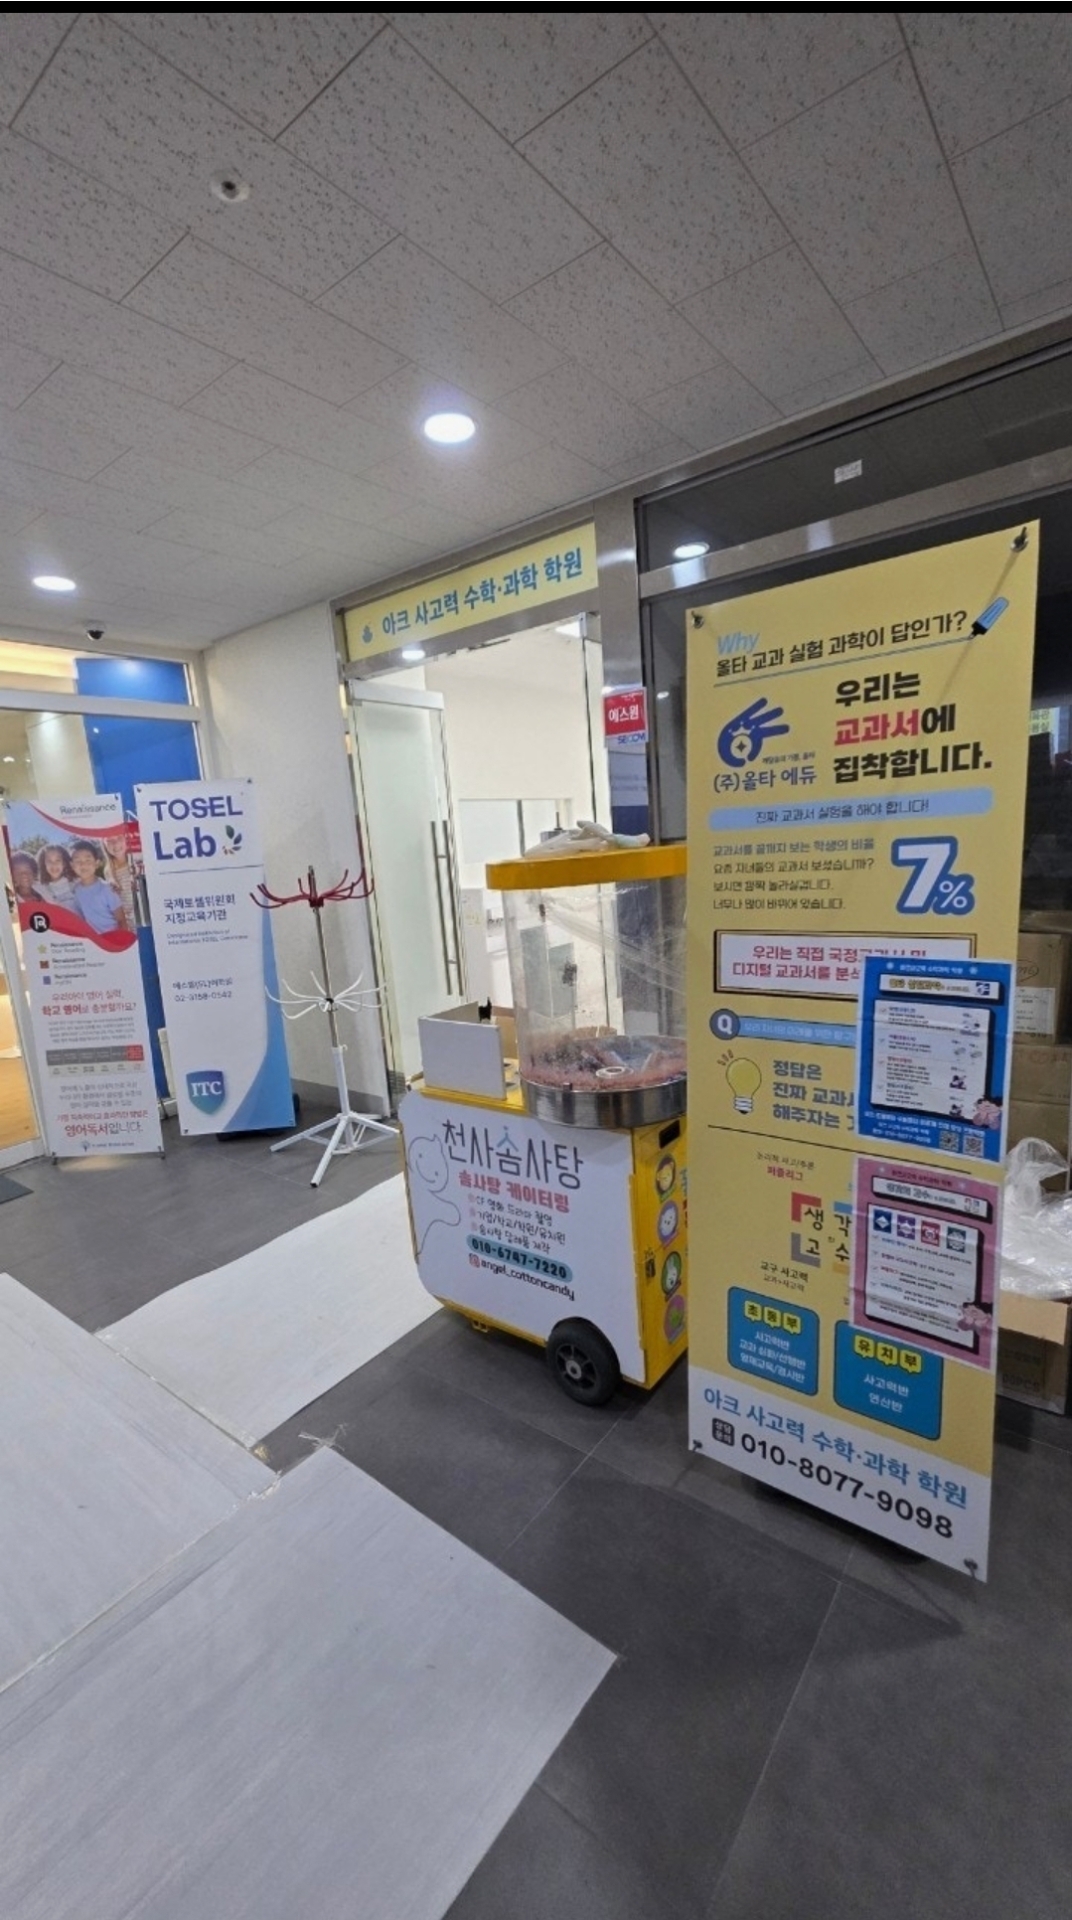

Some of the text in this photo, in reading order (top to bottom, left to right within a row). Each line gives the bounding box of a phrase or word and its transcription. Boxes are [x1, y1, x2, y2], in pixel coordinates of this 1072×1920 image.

[382, 612, 410, 636] 아크
[414, 591, 458, 626] 사고력
[543, 548, 583, 584] 학원
[716, 610, 967, 678] 올타 교과 실험 과학이 답인가?
[717, 631, 759, 654] Why
[835, 672, 921, 707] 우리는
[608, 703, 639, 723] 에스원
[834, 703, 957, 746] 교과서에
[833, 742, 992, 785] 집착합니다.
[713, 766, 817, 793] (주)올타 에듀
[59, 802, 117, 815] Renaissance
[149, 795, 243, 822] TOSEL
[755, 799, 930, 824] 진짜 교과서 실험을 해야 합니다!
[153, 826, 217, 861] Lab
[713, 844, 753, 857] 교과서를
[789, 841, 811, 853] 보는
[813, 839, 848, 852] 학생의
[851, 838, 874, 850] 비율
[713, 863, 732, 874] 요즘
[735, 861, 775, 874] 자녀들의
[777, 860, 809, 873] 교과서
[713, 880, 743, 892] 보시면
[744, 879, 766, 892] 깜짝
[713, 898, 743, 909] 너무나
[744, 898, 765, 909] 많이
[164, 910, 228, 925] 지정교육기관
[753, 945, 793, 960] 우리는
[796, 946, 825, 962] 직접
[732, 962, 771, 978] 디지털
[776, 963, 832, 980] 교과서를
[42, 1004, 61, 1016] 학교
[717, 1014, 733, 1035] Q
[773, 1059, 822, 1081] 정답은
[190, 1080, 223, 1098] ITC
[772, 1081, 807, 1100] 진짜
[773, 1102, 842, 1129] 해주자는
[442, 1119, 584, 1190] 천사솜사탕
[458, 1169, 570, 1214] 솜사탕 케이터링
[471, 1237, 567, 1279] 010-6747-7220
[481, 1258, 575, 1301] angel_cottoncandy
[761, 1260, 809, 1283] 교구 사고력
[704, 1387, 742, 1417] 아크
[746, 1404, 805, 1443] 사고력
[917, 1468, 967, 1509] 학원
[741, 1433, 953, 1539] 010-8077-9098
